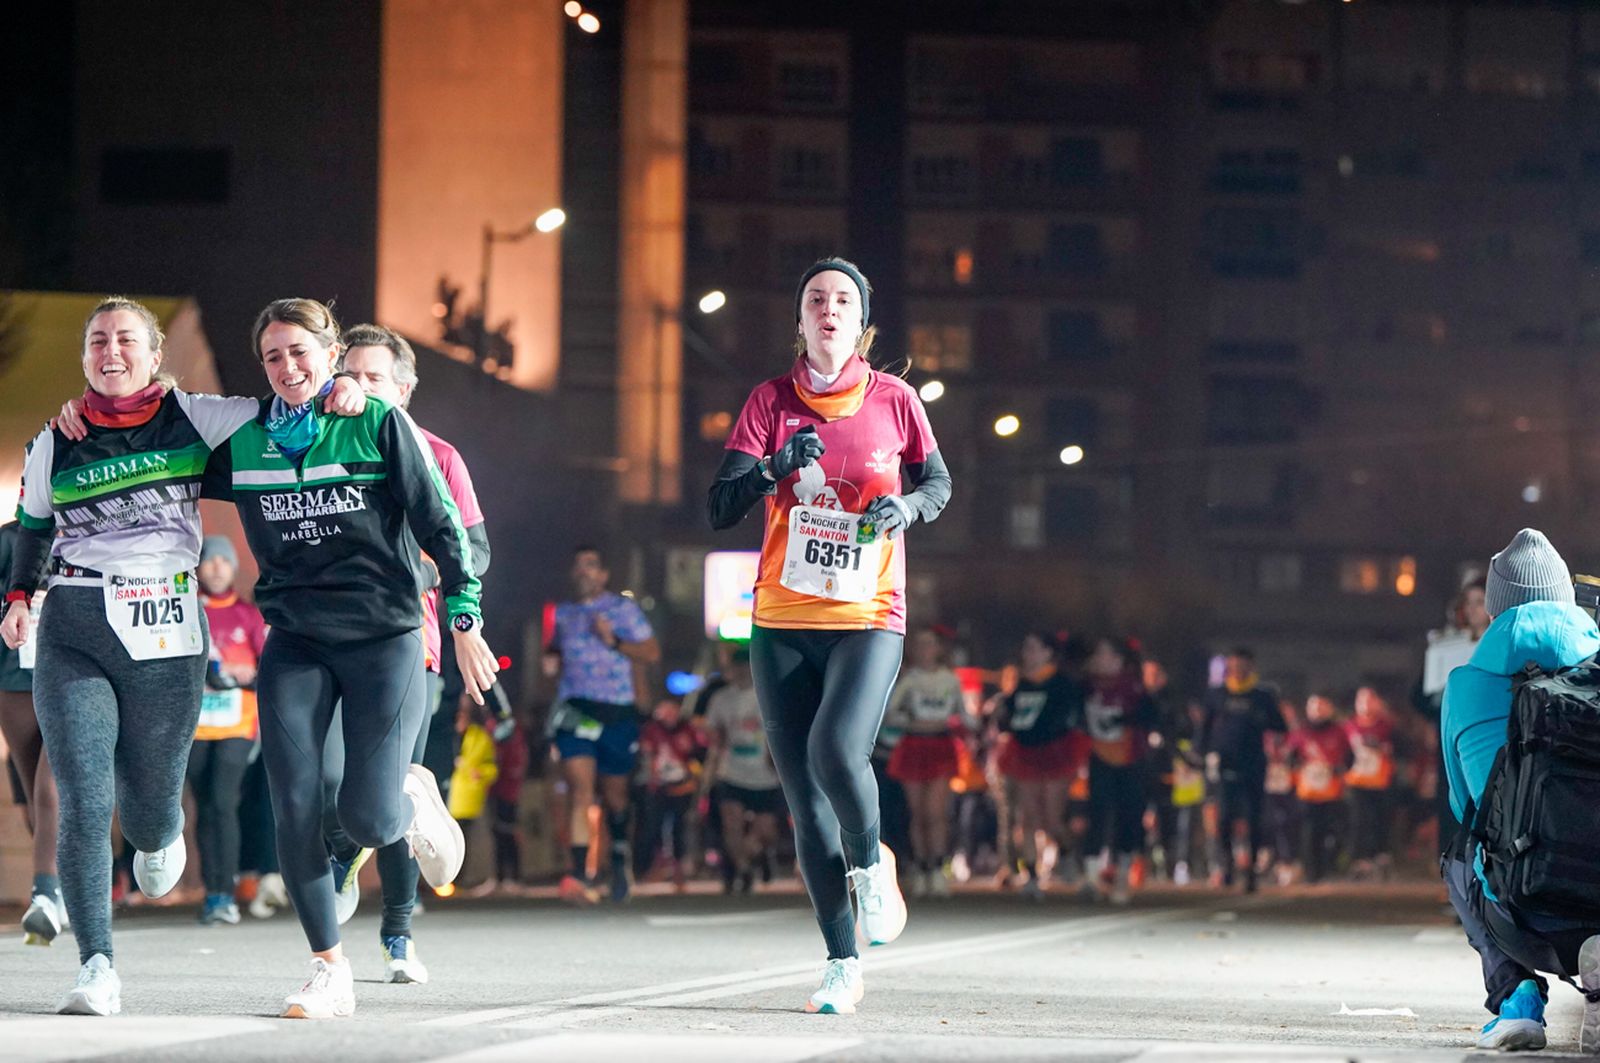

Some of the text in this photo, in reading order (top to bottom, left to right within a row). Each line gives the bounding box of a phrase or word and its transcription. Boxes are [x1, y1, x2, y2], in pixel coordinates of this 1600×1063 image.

[76, 452, 168, 486] SERMAN
[76, 464, 170, 493] TRIATLON MARBELLA
[260, 486, 366, 513] SERMAN
[263, 501, 367, 521] TRIATLON MARBELLA
[282, 525, 342, 541] MARBELLA
[799, 525, 817, 537] SAN
[810, 517, 837, 530] NOCHE
[838, 522, 850, 531] DE
[804, 538, 862, 571] 6351
[117, 589, 138, 600] SAN
[139, 585, 170, 598] ANN
[127, 597, 184, 628] 7025
